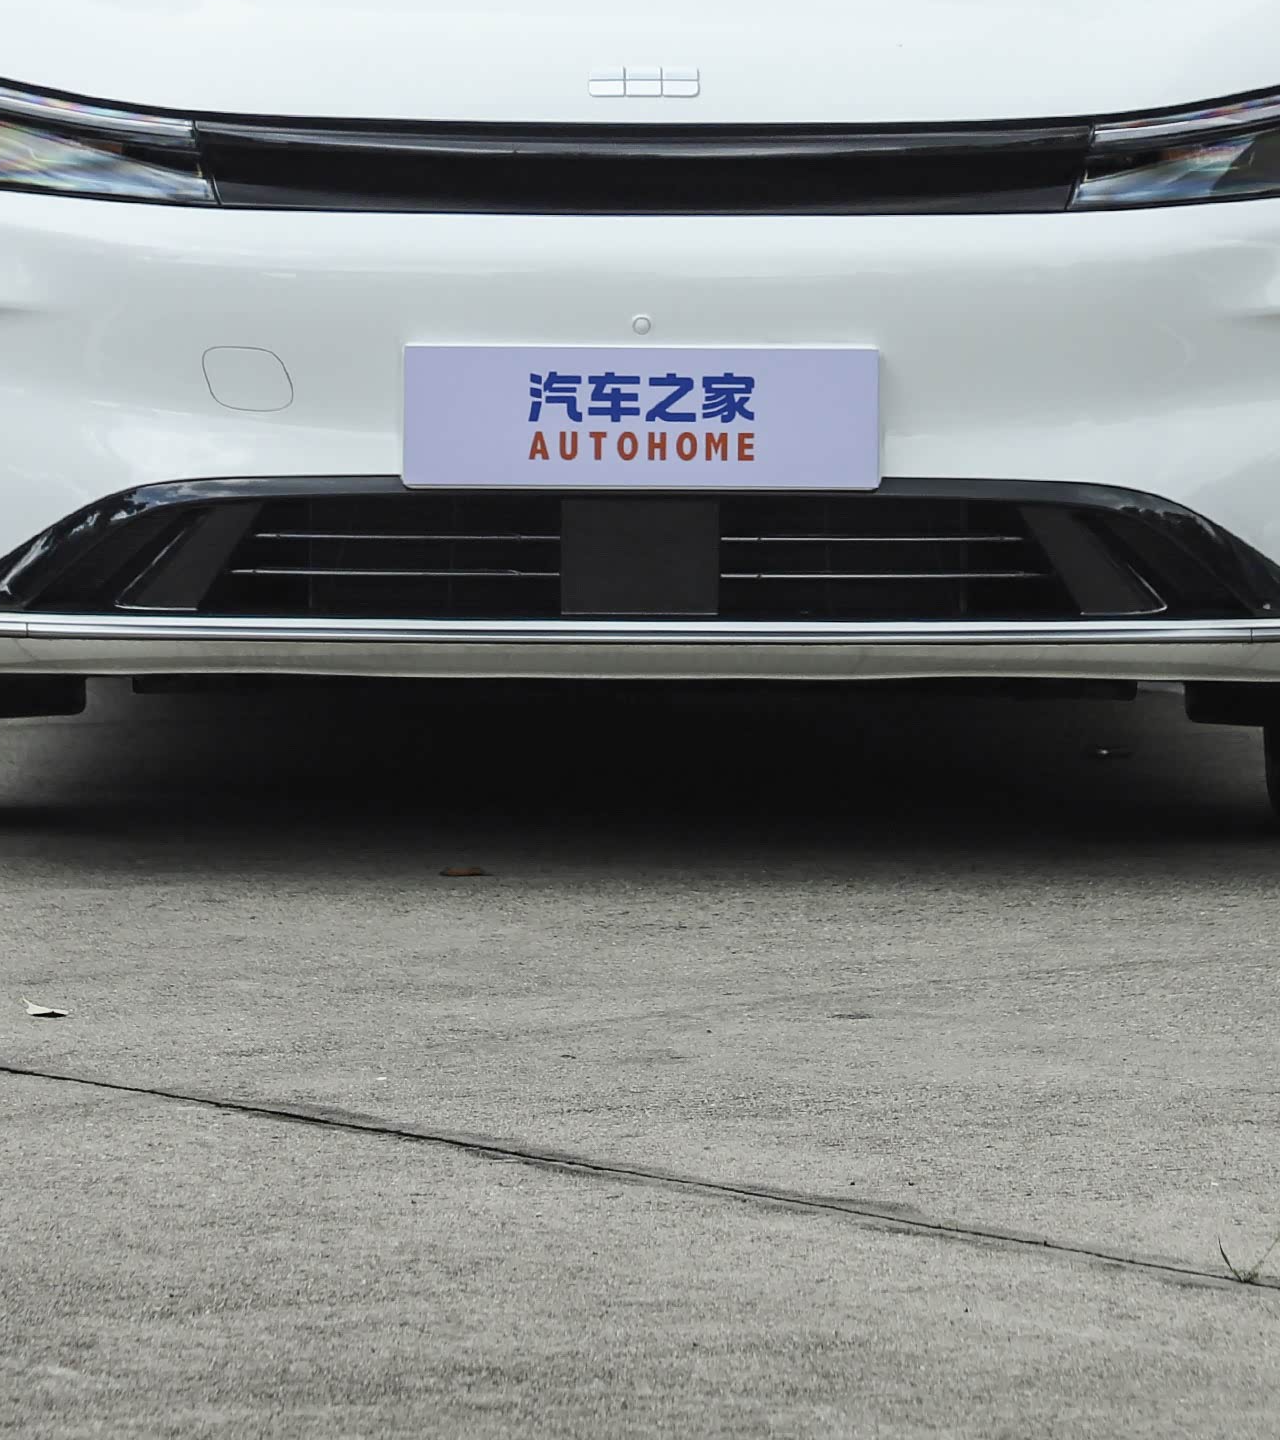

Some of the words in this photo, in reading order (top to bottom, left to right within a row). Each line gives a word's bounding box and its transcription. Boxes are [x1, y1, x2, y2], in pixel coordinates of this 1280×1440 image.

[528, 371, 755, 423] 汽车之家
[528, 431, 755, 462] AUTOHOME
